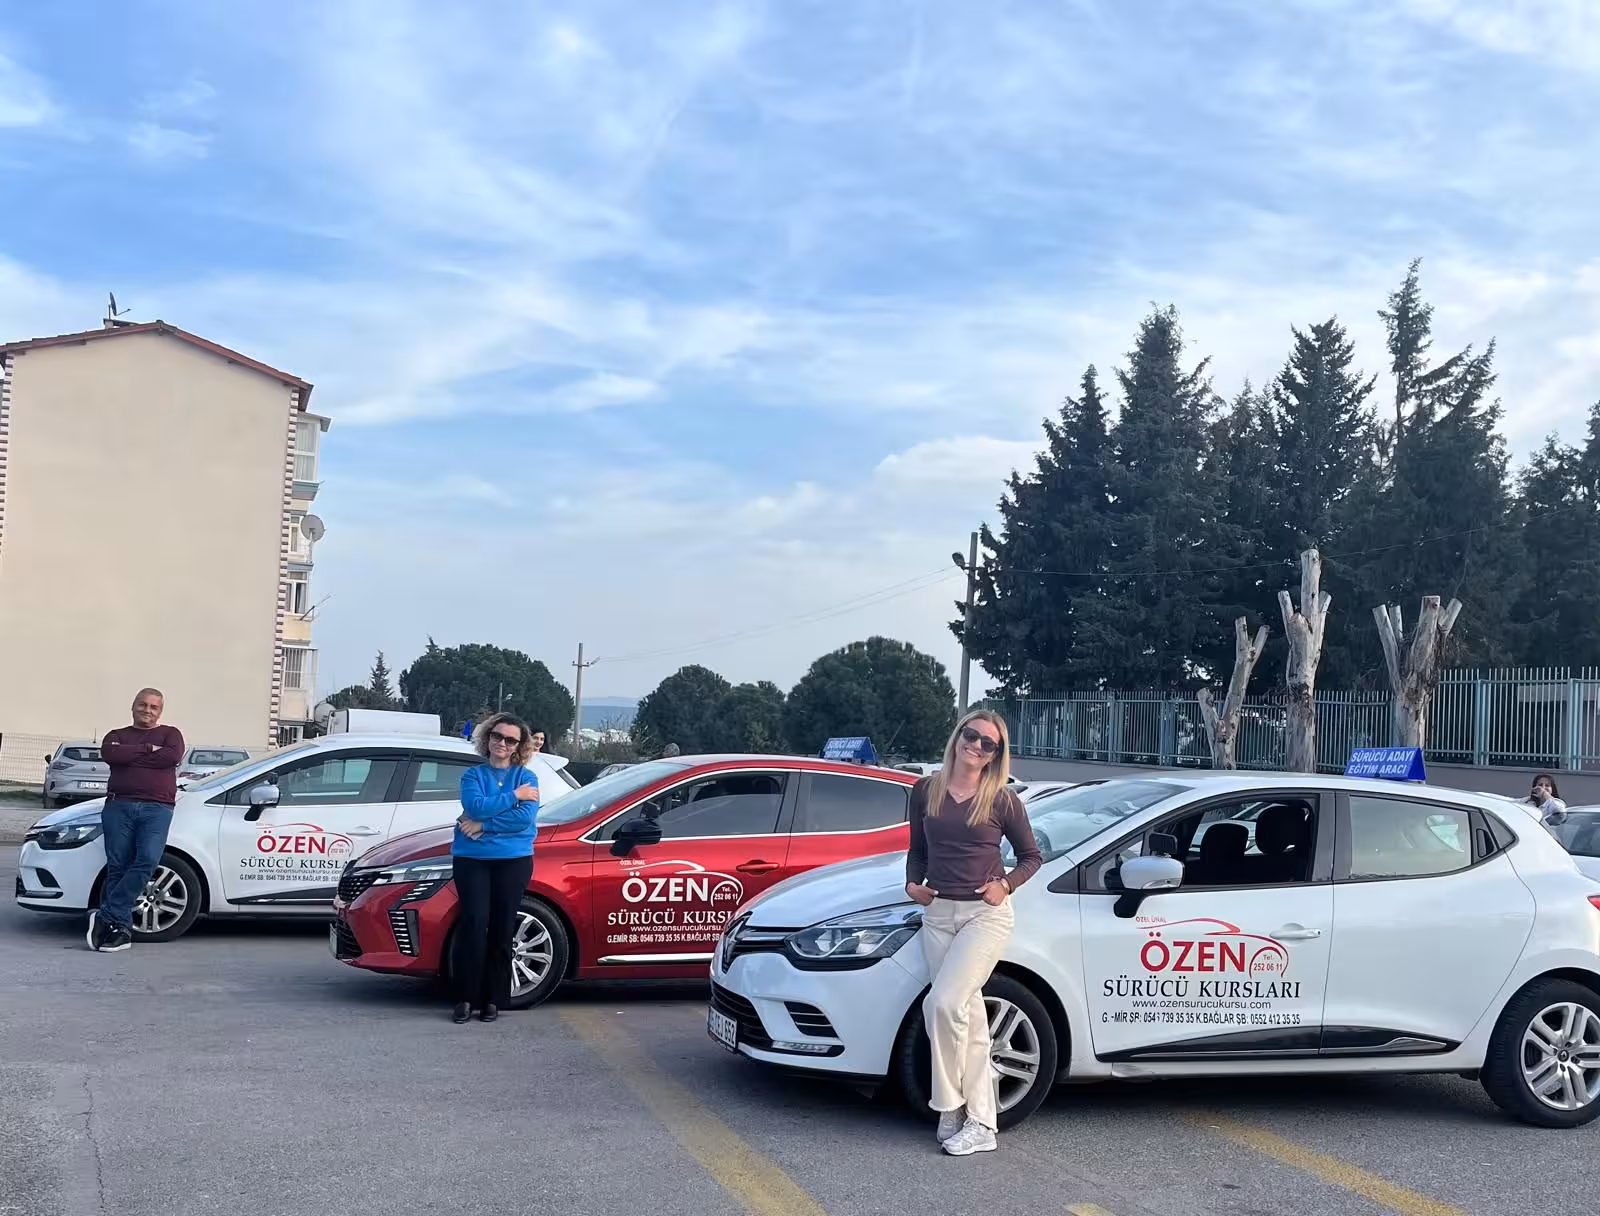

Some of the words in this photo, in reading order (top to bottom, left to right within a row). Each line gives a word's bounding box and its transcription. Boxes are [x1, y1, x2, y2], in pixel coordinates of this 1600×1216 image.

[1351, 750, 1387, 762] SÜRÜCÜ
[1387, 750, 1416, 762] ADAYI
[1379, 764, 1408, 775] ARACI
[257, 830, 326, 854] ÖZEN
[240, 856, 294, 868] SÜRÜCÜ
[300, 859, 348, 869] KURSLA
[622, 871, 709, 903] ÖZEN
[607, 908, 676, 926] SÜRÜCÜ
[630, 924, 724, 932] www.ozensurucukursu.
[1140, 931, 1246, 973] ÖZEN
[1253, 962, 1266, 972] 252
[1276, 962, 1284, 972] 11
[1103, 974, 1189, 998] SÜRÜCÜ
[1199, 980, 1301, 999] KURSLARI
[1132, 999, 1272, 1010] www.ozensurucukursu.com
[1161, 1011, 1174, 1023] 739
[1175, 1012, 1185, 1023] 35
[1185, 1012, 1195, 1024] 35
[1195, 1010, 1235, 1024] K.BAĞLAR
[1250, 1013, 1268, 1025] 0552
[1268, 1013, 1281, 1025] 412
[1281, 1013, 1291, 1025] 35
[1291, 1013, 1301, 1025] 35
